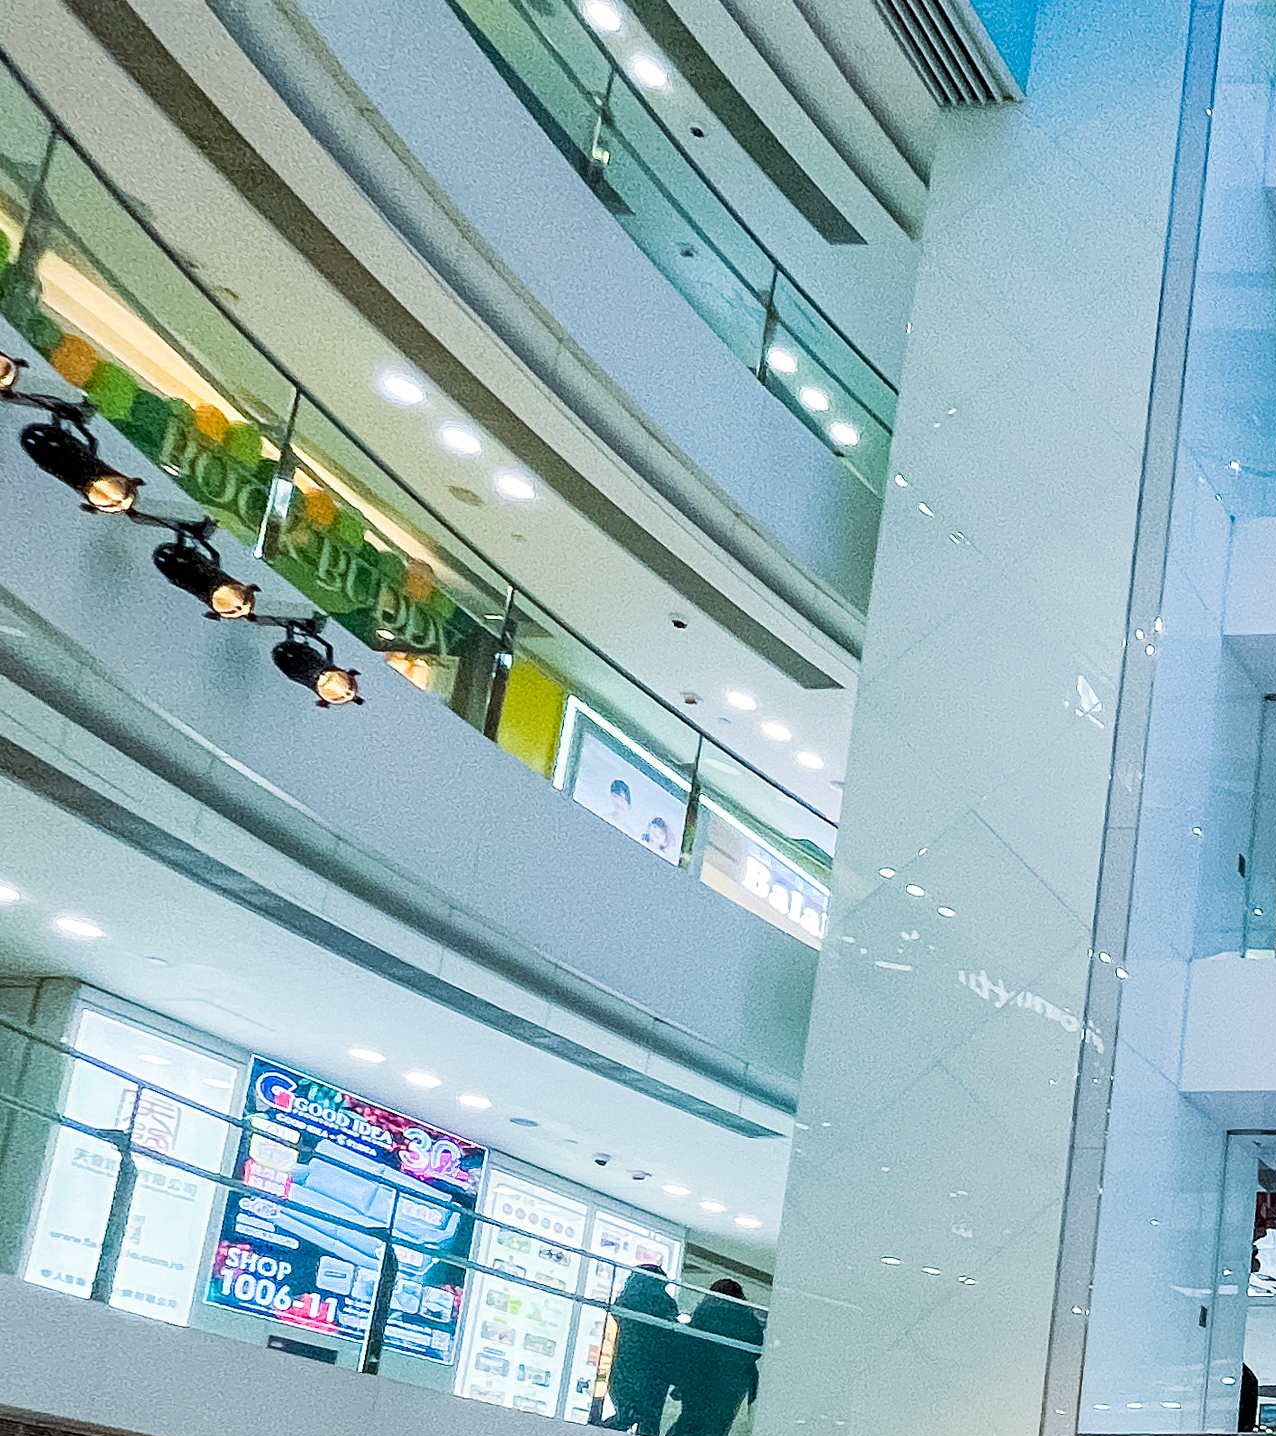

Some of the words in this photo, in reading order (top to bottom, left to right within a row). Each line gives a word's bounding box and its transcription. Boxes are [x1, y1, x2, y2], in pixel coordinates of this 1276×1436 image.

[742, 855, 828, 939] Bala
[293, 1096, 351, 1128] GOOD
[352, 1118, 394, 1145] IDEA
[224, 1247, 292, 1281] SHOP
[219, 1267, 339, 1323] 1006-11
